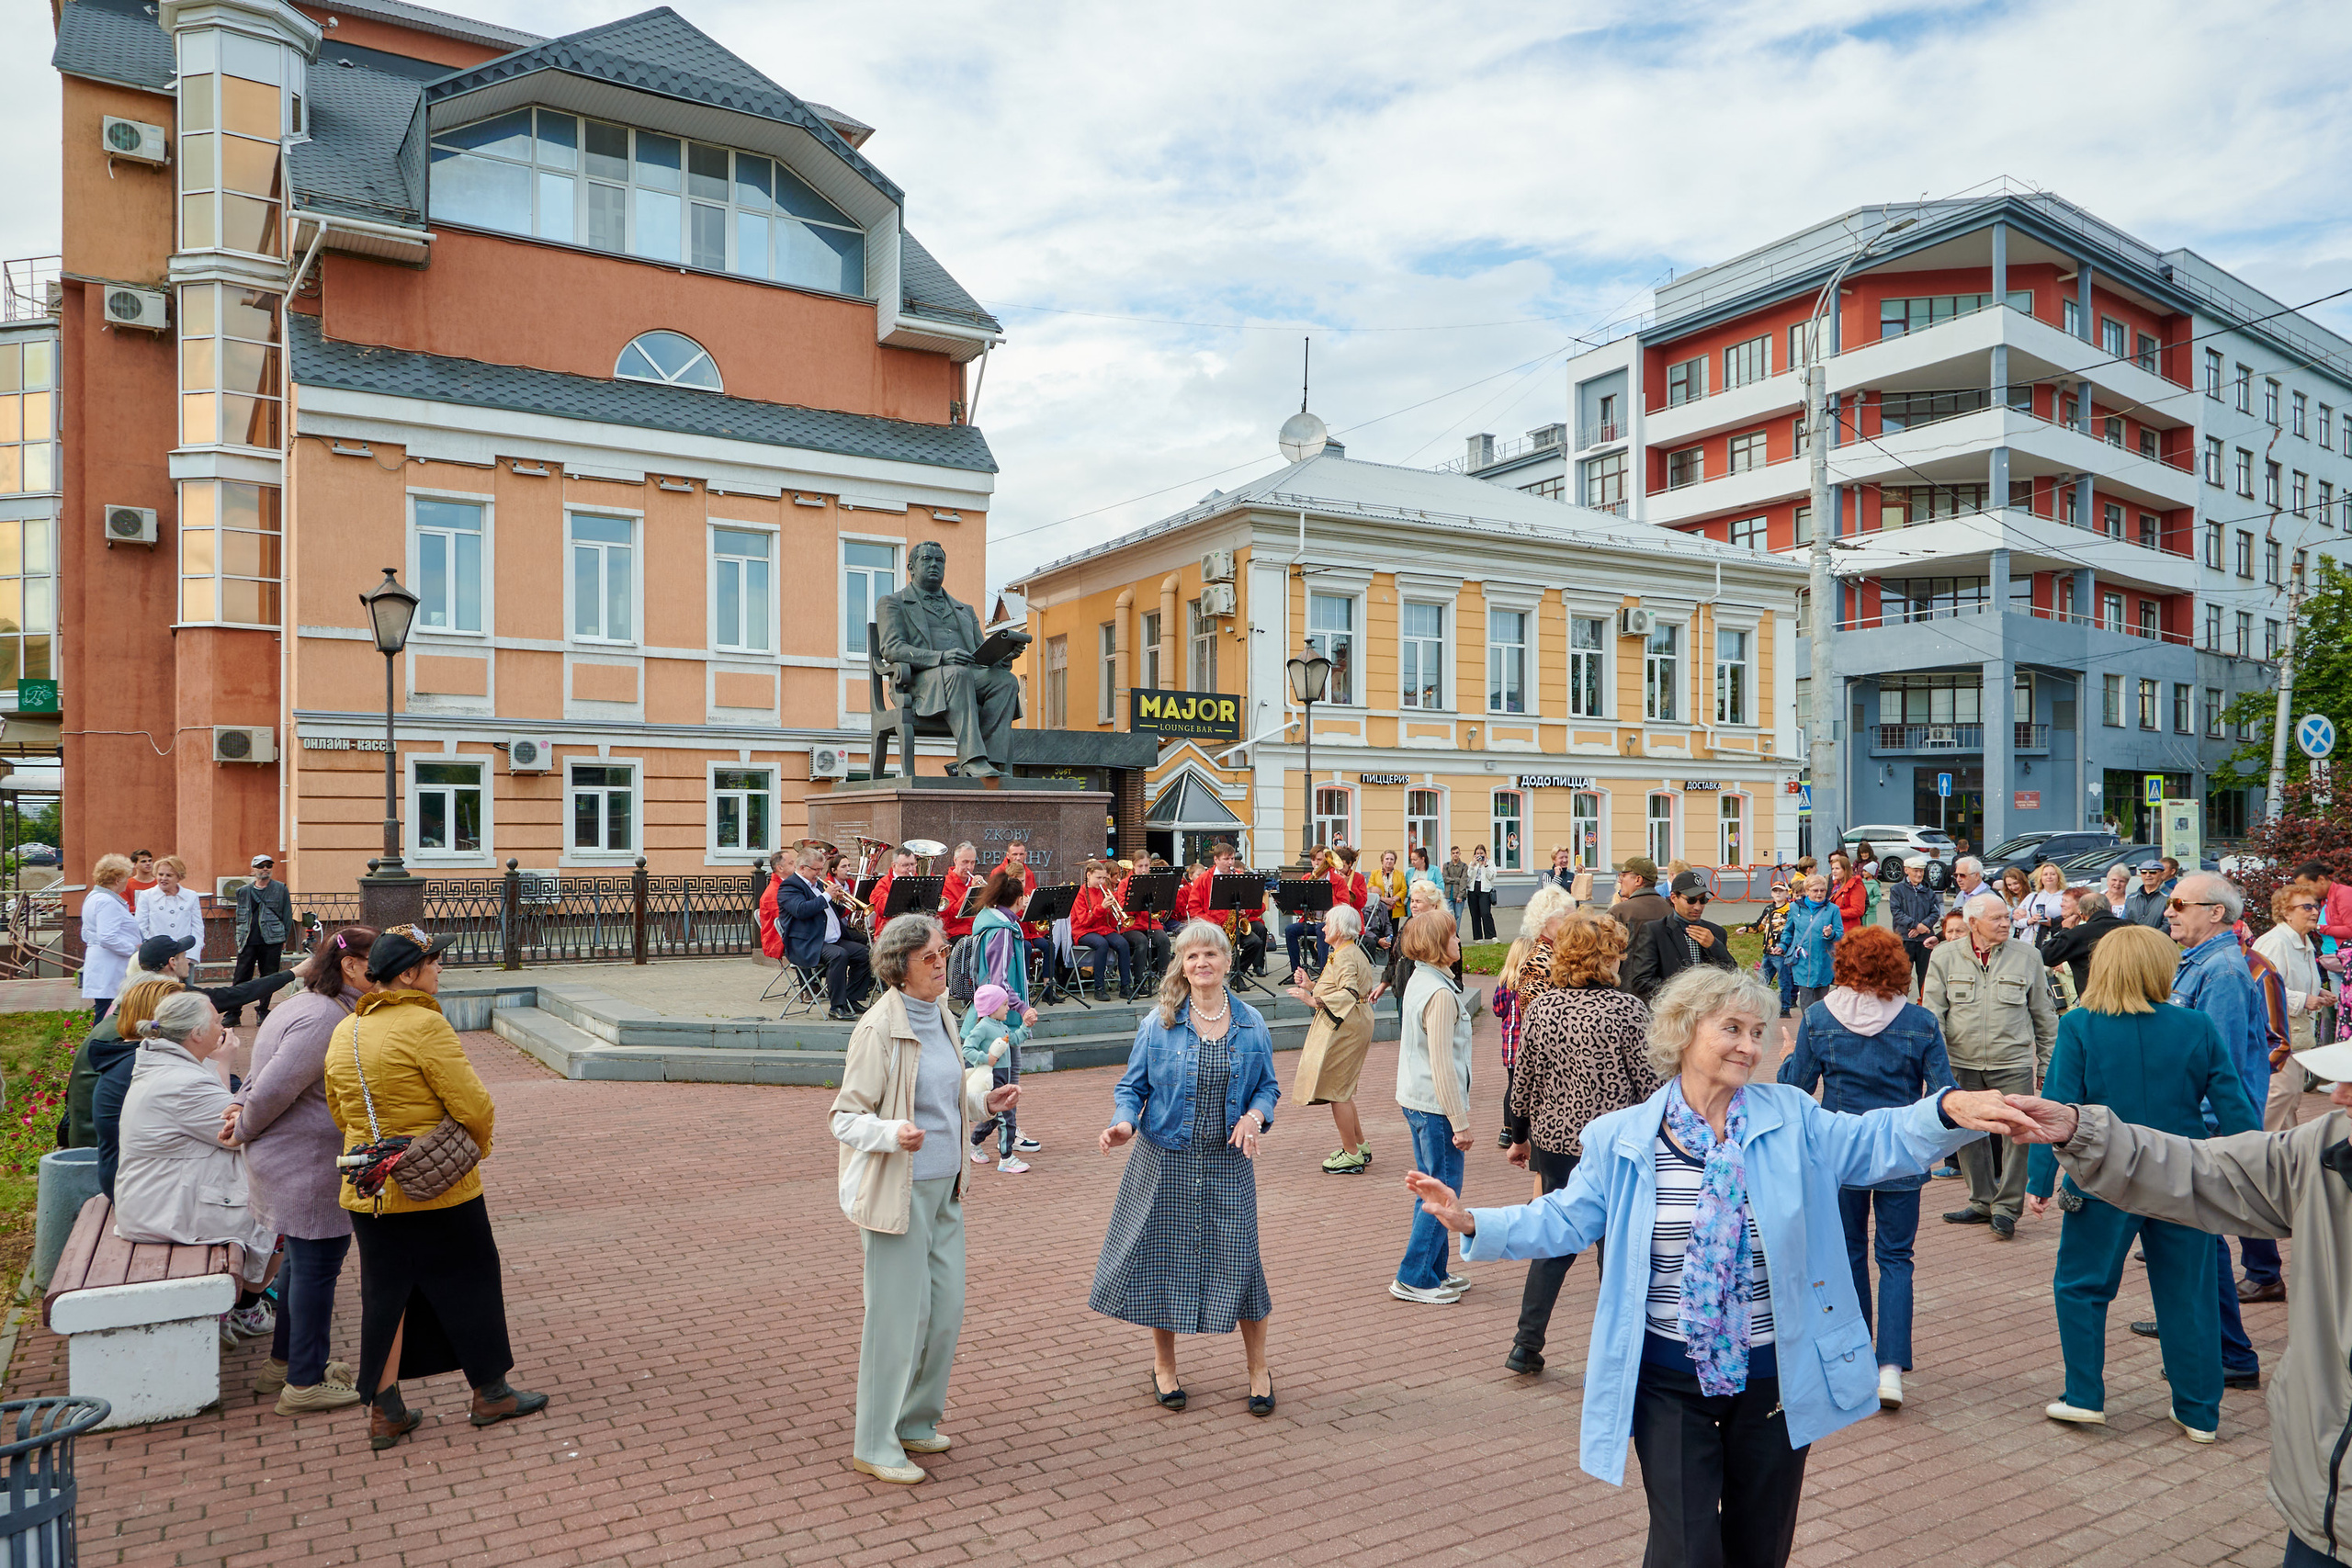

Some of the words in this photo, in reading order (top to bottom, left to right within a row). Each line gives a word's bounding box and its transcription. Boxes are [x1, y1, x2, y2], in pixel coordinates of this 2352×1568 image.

[1139, 694, 1236, 722] MAJOR
[1159, 723, 1194, 732] LOUNGE
[303, 738, 397, 751] онлайн-касс
[1362, 773, 1410, 785] ПИЦЦЕРИЯ
[1521, 775, 1552, 788] ДОДО
[1553, 776, 1589, 789] ПИЦЦА
[1686, 781, 1723, 791] ДОСТАВКА
[984, 829, 1032, 842] ЯКОВУ
